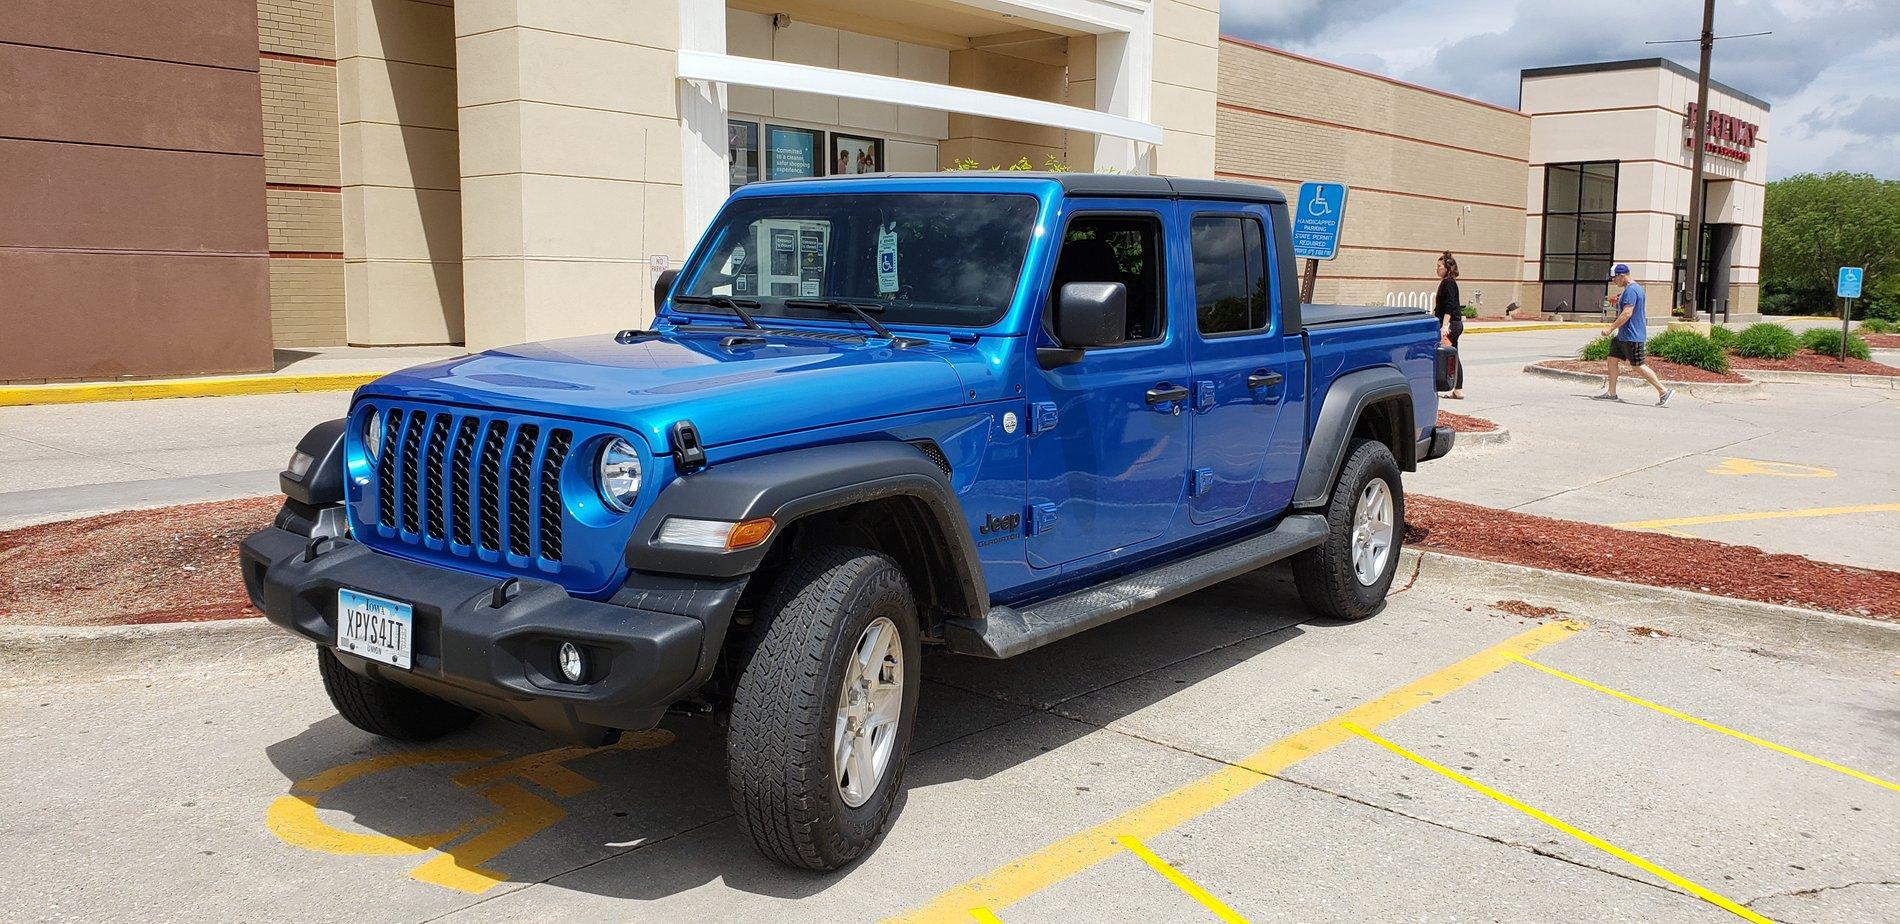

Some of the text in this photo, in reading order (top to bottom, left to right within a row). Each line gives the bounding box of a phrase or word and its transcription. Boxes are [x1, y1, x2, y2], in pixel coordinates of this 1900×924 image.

[1687, 102, 1759, 149] FREWAY
[776, 147, 803, 155] Committed
[789, 161, 810, 169] shopping
[1297, 218, 1336, 226] HANDICAPPED
[980, 512, 1020, 535] Jeep
[346, 608, 404, 651] XPYS4IT
